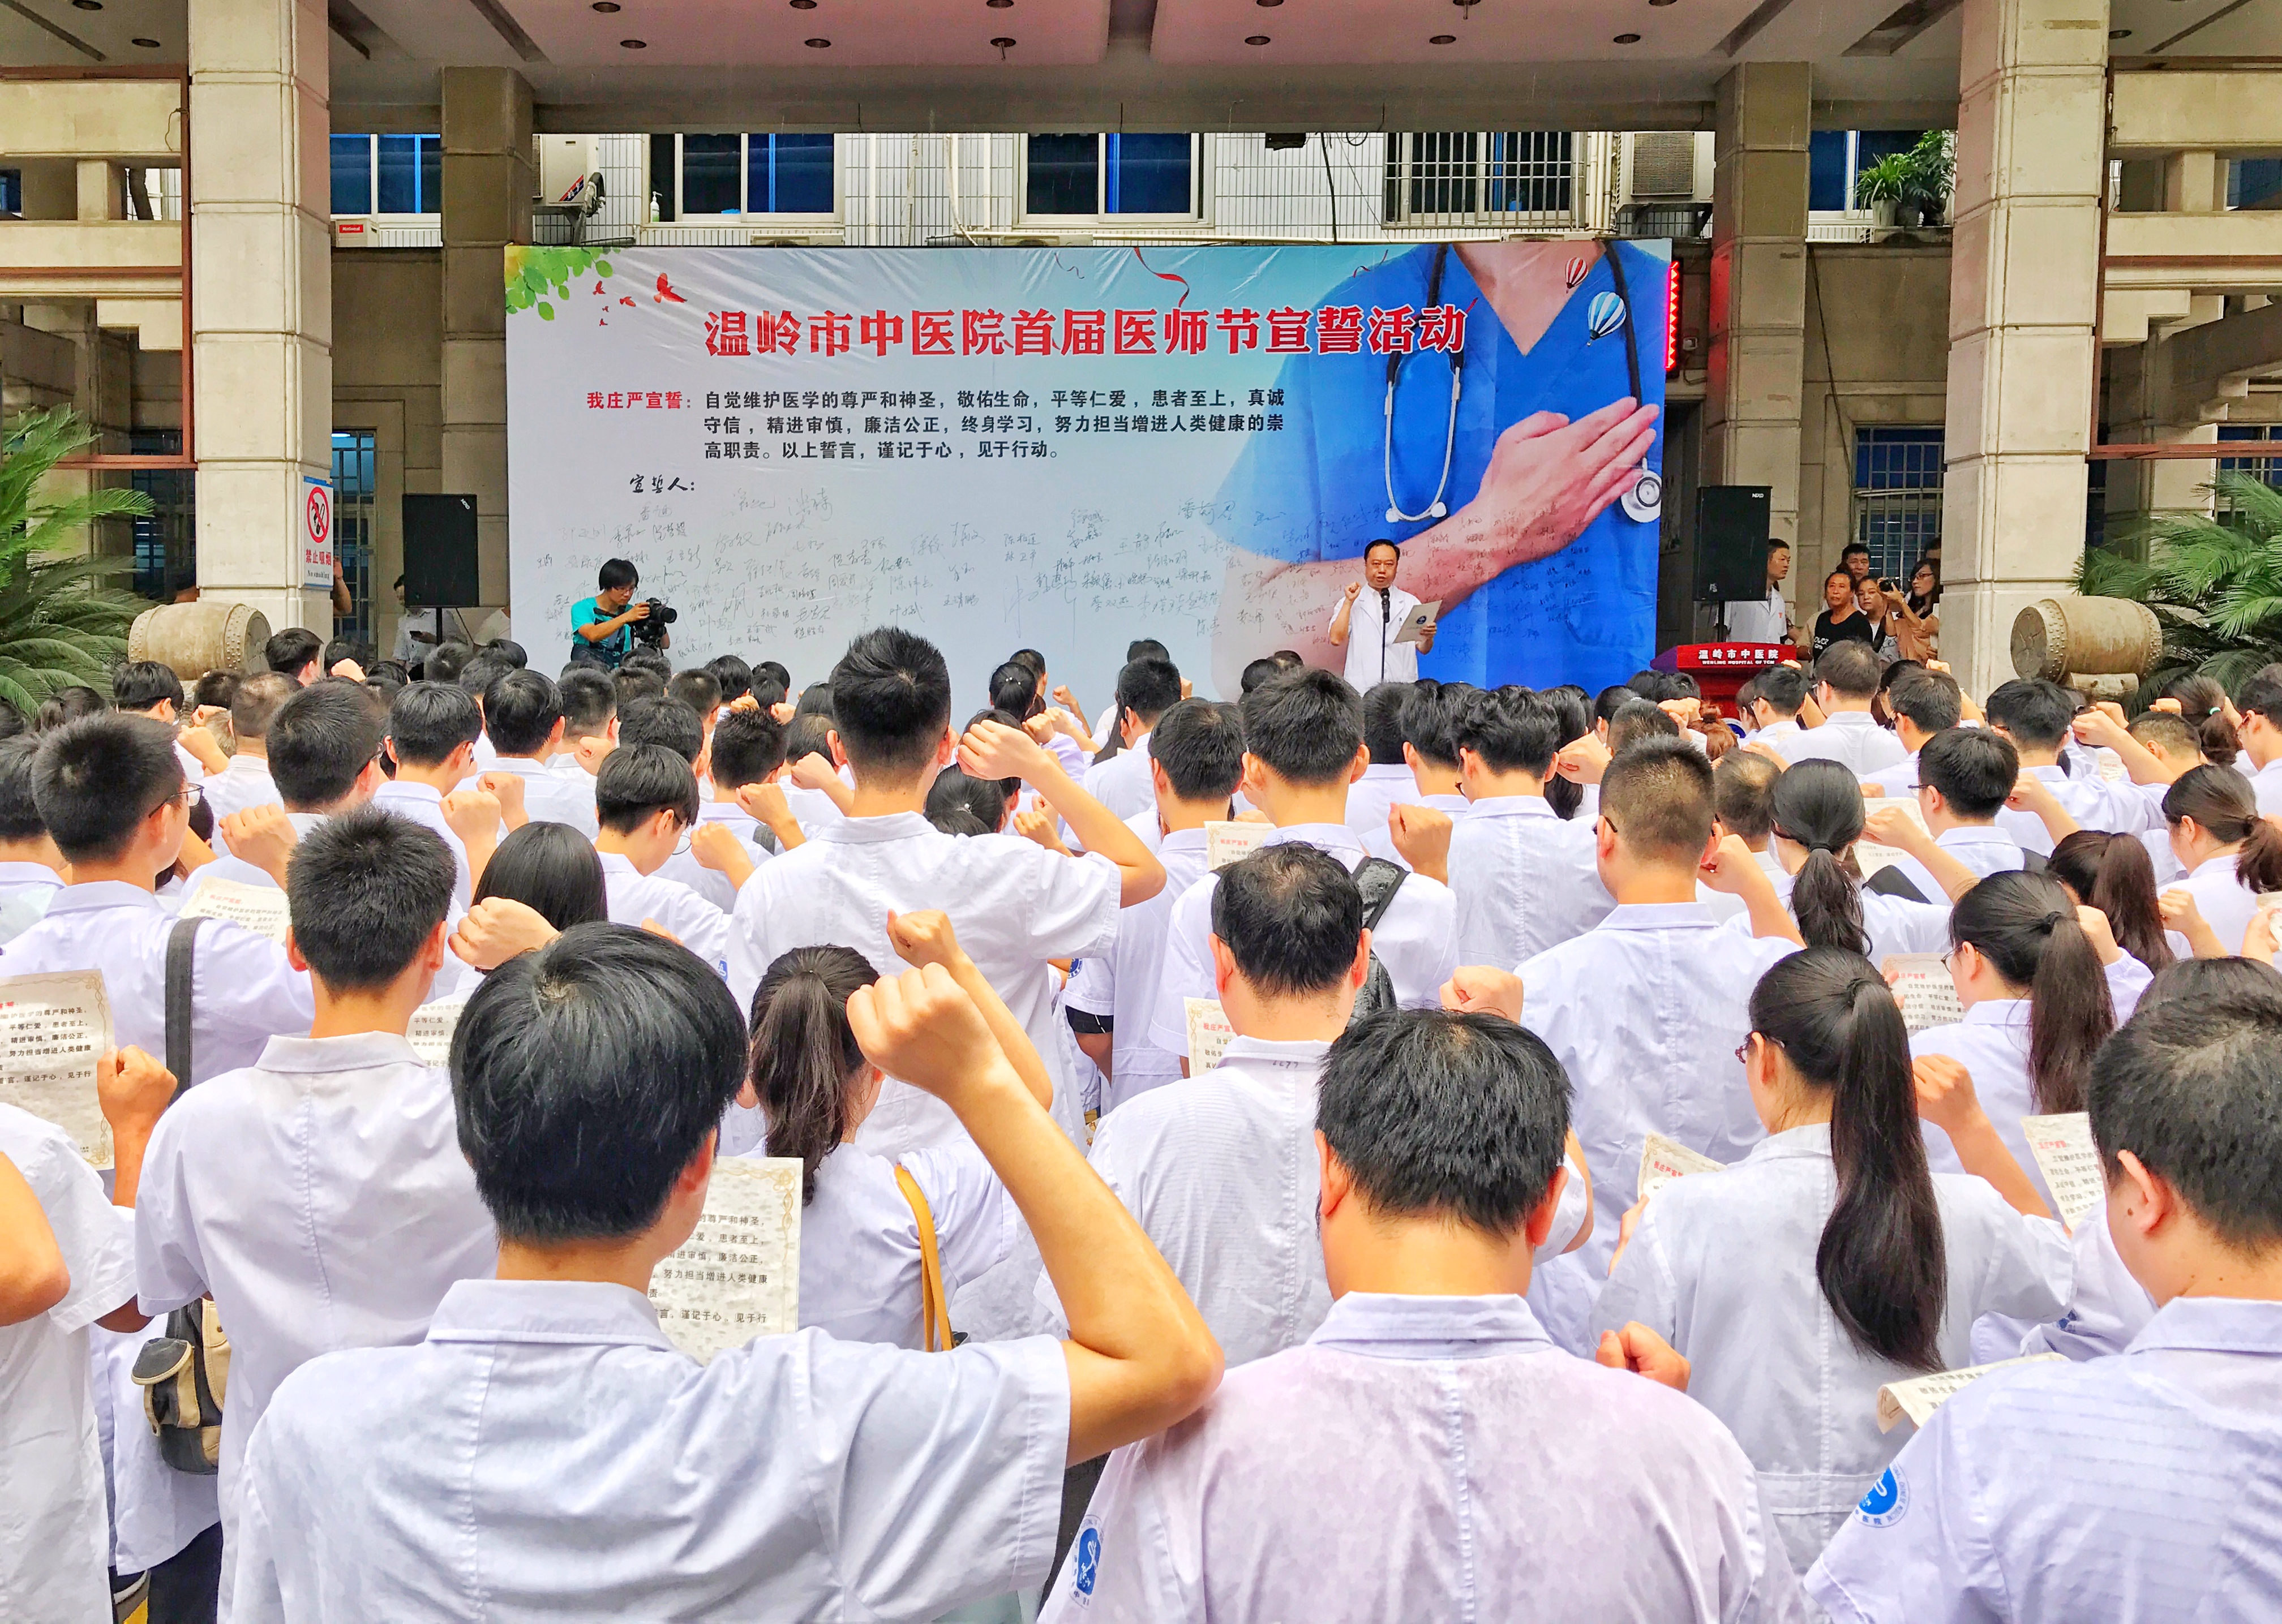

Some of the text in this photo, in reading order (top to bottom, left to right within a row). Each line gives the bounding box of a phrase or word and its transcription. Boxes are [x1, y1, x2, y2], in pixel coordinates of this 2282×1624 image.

[704, 304, 1467, 357] 温岭市中医院首届医师节宣誓活动
[587, 391, 690, 409] 我庄严宣誓：
[306, 548, 332, 566] 禁止吸烟
[1698, 648, 1779, 659] 温岭市中医院
